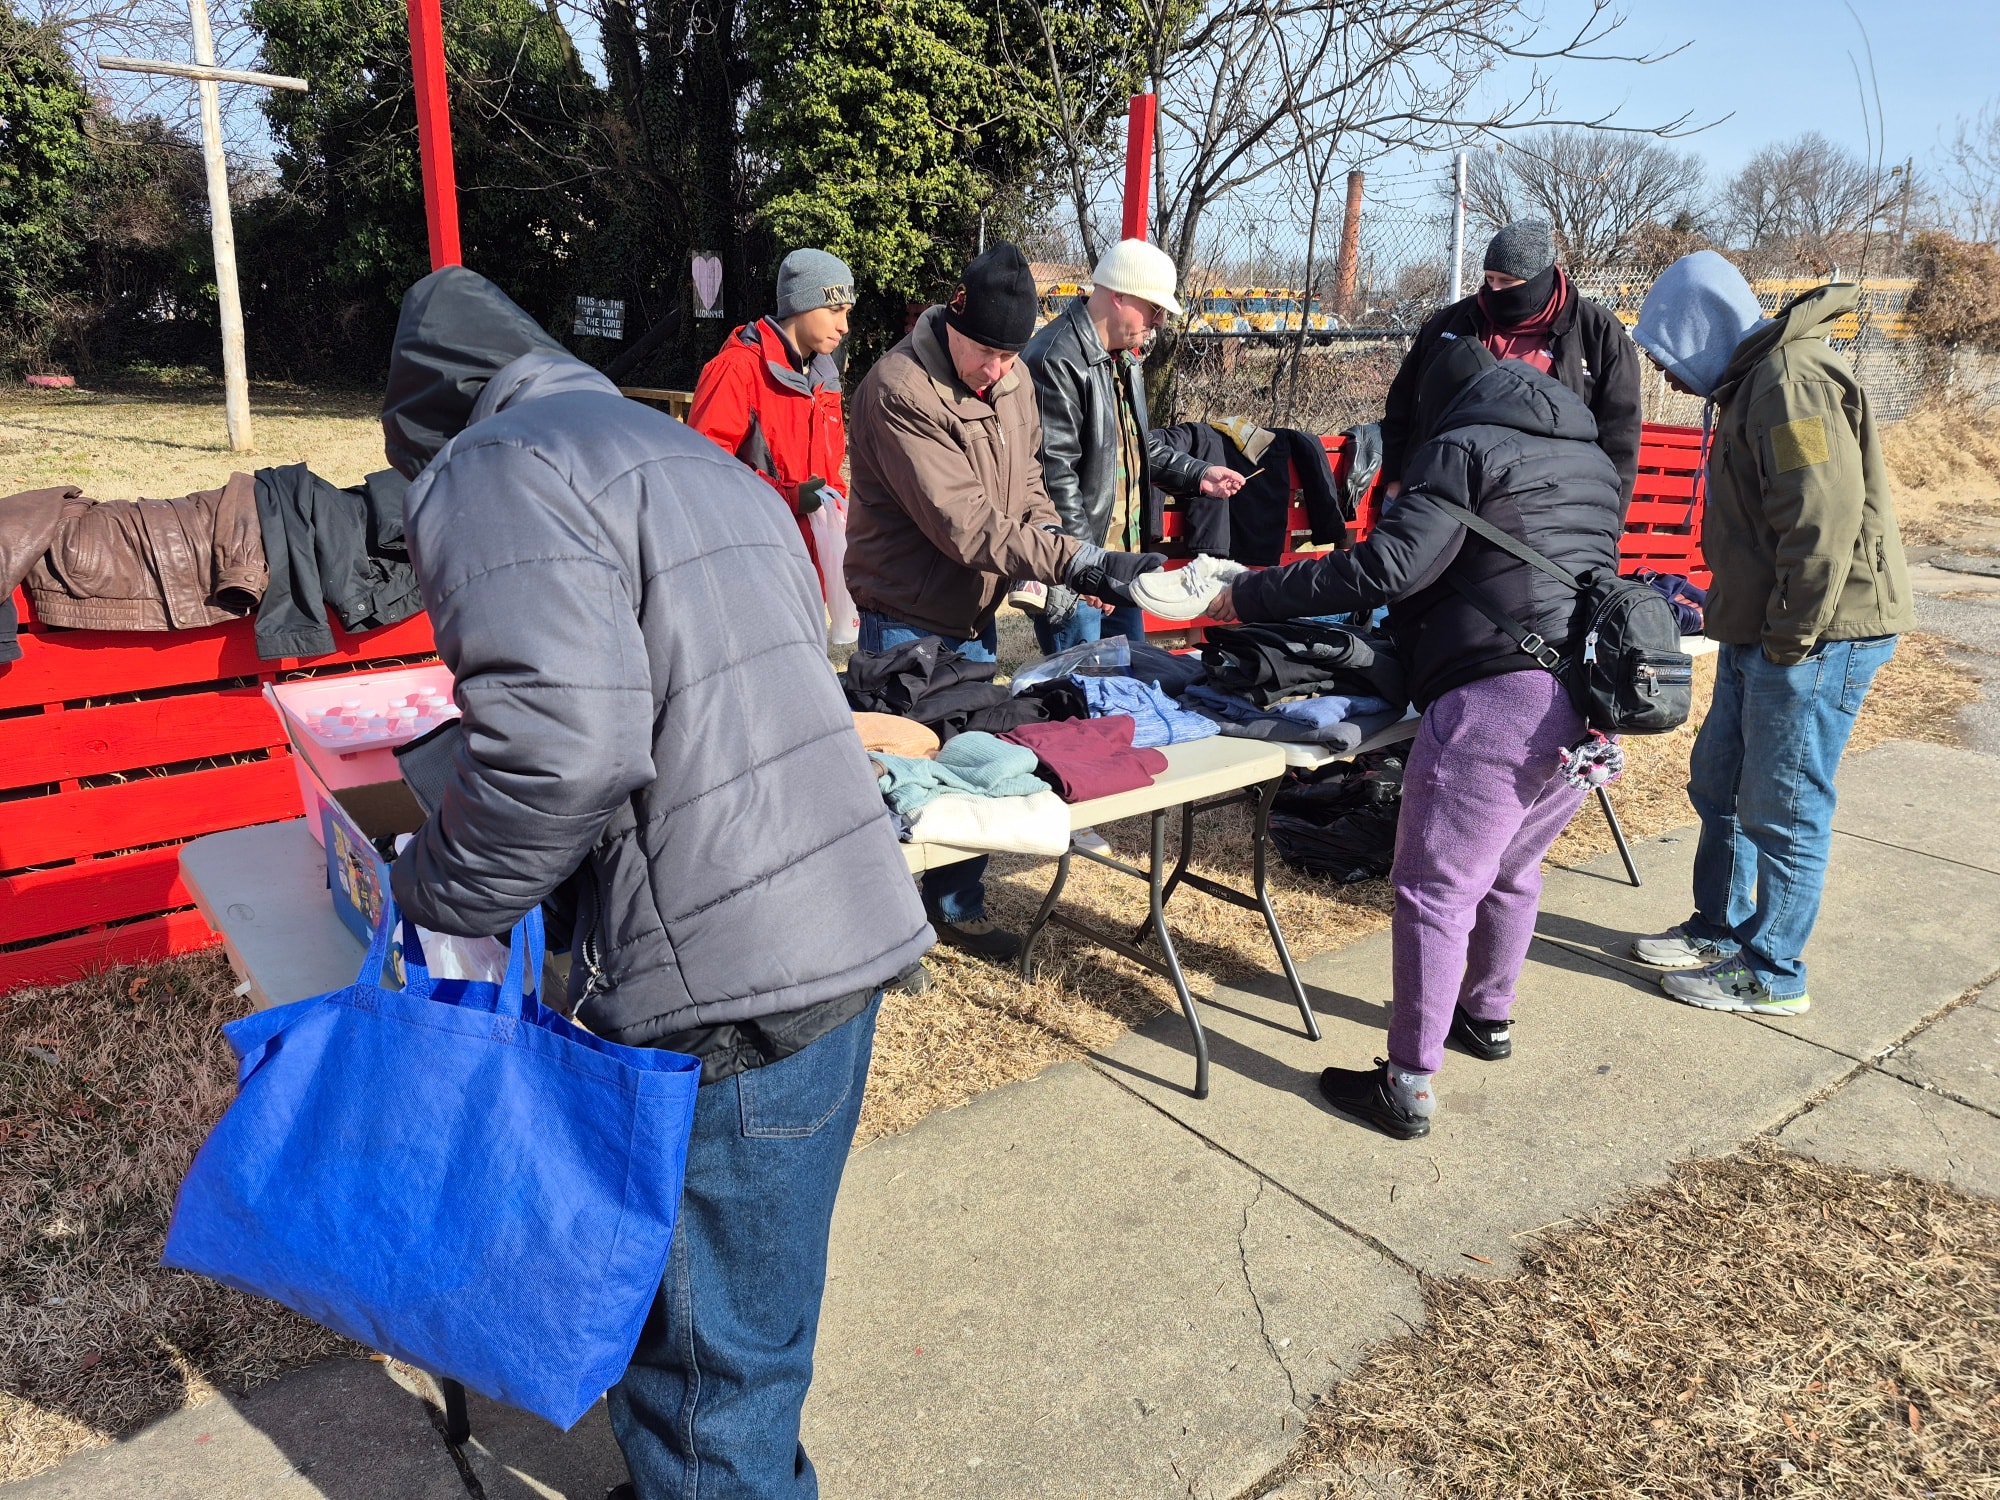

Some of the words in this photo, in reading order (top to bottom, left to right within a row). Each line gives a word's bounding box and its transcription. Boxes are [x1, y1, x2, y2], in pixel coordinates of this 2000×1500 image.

[822, 285, 847, 304] NEW
[577, 296, 594, 306] THIS
[598, 299, 606, 307] IS
[610, 300, 624, 310] THE
[601, 309, 619, 318] THAT
[585, 317, 600, 327] THE
[601, 319, 621, 329] LORD
[586, 327, 600, 336] HAS
[602, 329, 621, 339] MADE
